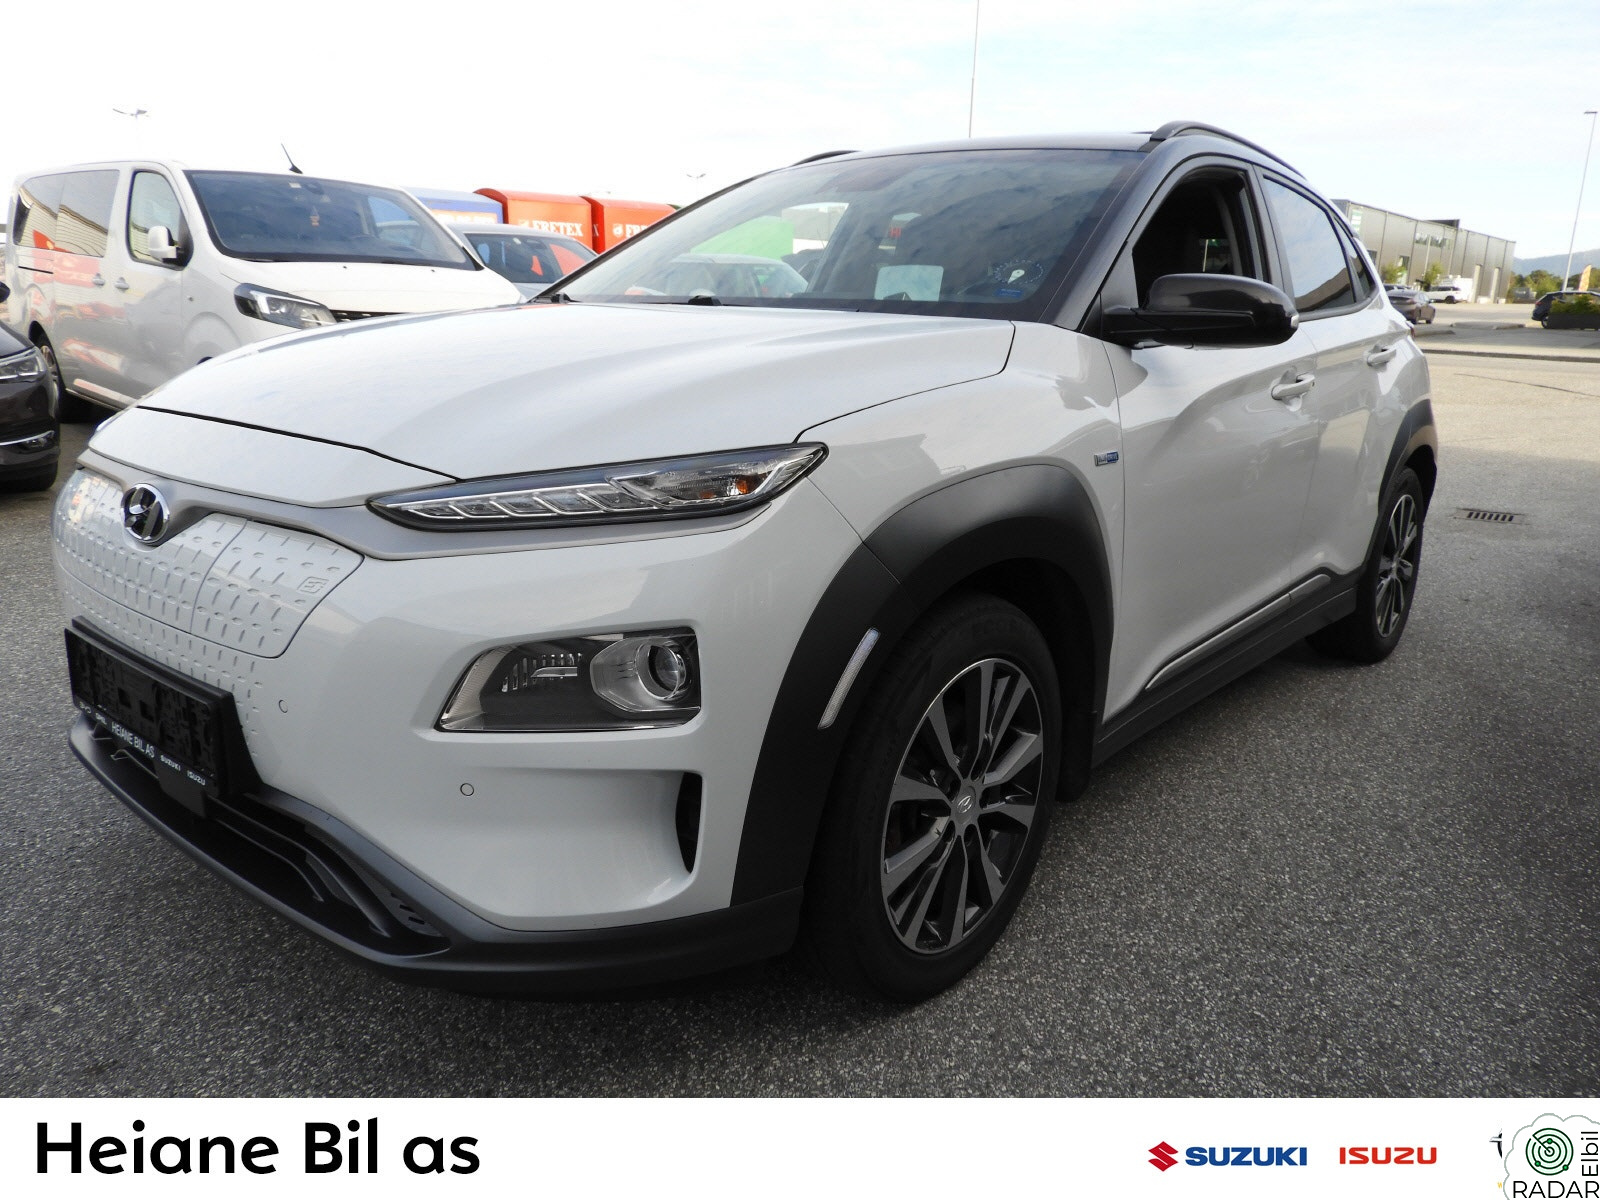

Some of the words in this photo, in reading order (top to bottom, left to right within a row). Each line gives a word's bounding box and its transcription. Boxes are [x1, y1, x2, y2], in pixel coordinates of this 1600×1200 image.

[533, 220, 583, 237] FRETEX
[134, 736, 145, 752] BIL
[145, 743, 155, 758] AS
[160, 754, 181, 771] SUZUKI
[187, 770, 206, 786] ISUZU
